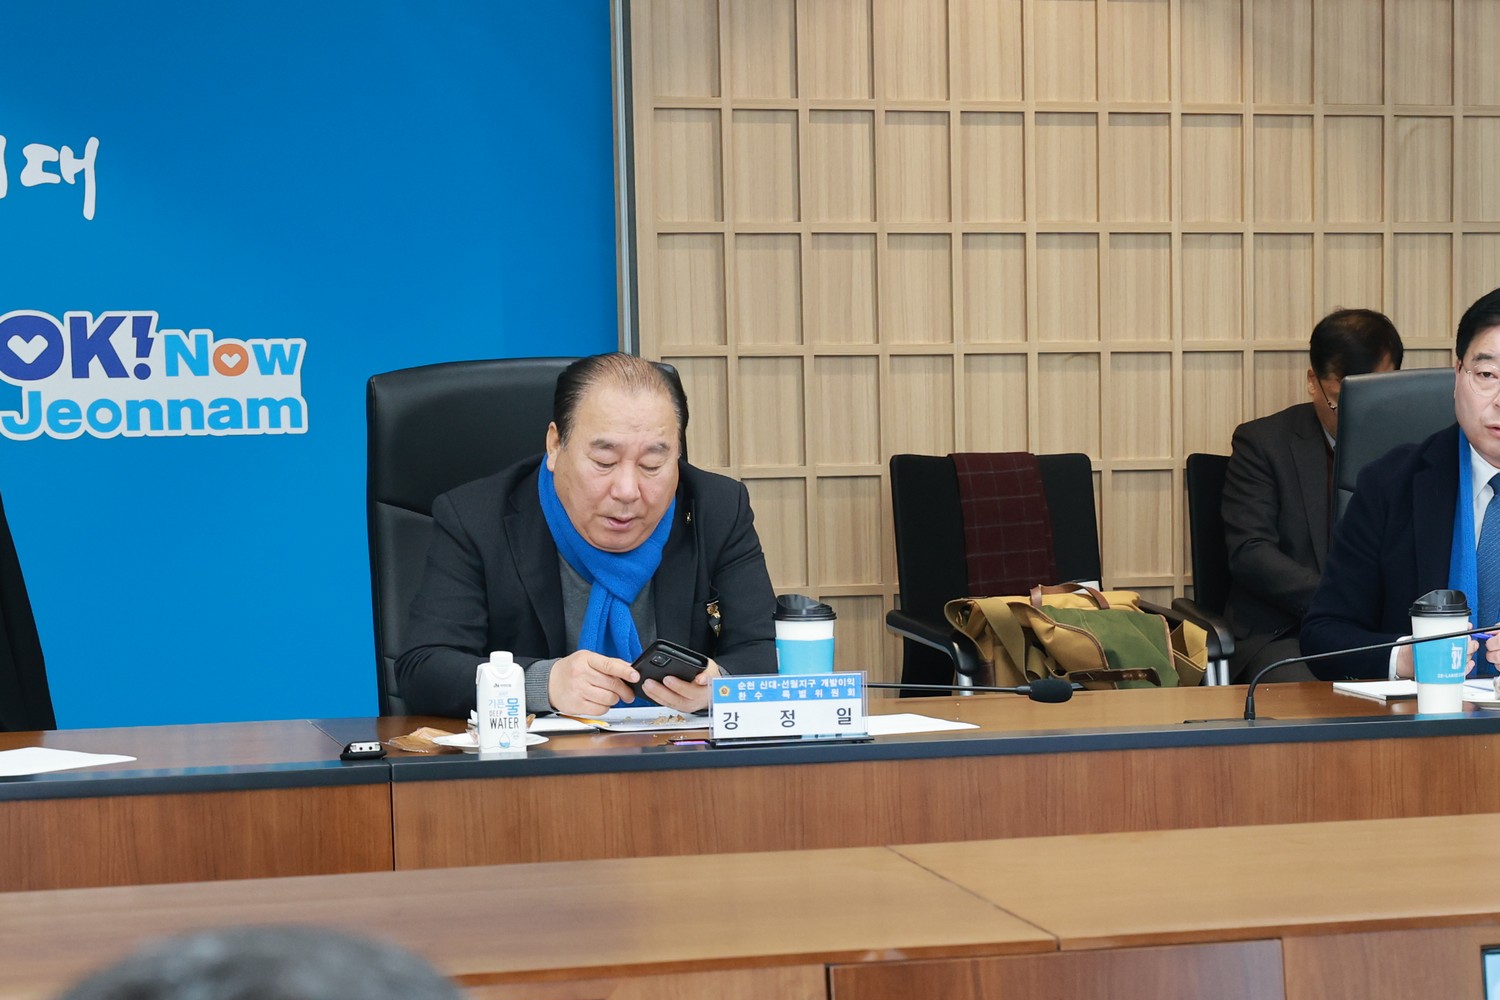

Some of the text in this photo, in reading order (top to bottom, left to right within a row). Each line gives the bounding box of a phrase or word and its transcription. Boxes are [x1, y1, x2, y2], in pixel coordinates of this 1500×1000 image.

[0, 134, 99, 221] 대
[0, 315, 154, 380] OK!
[1, 390, 303, 435] Jeonnam
[489, 717, 519, 730] WATER
